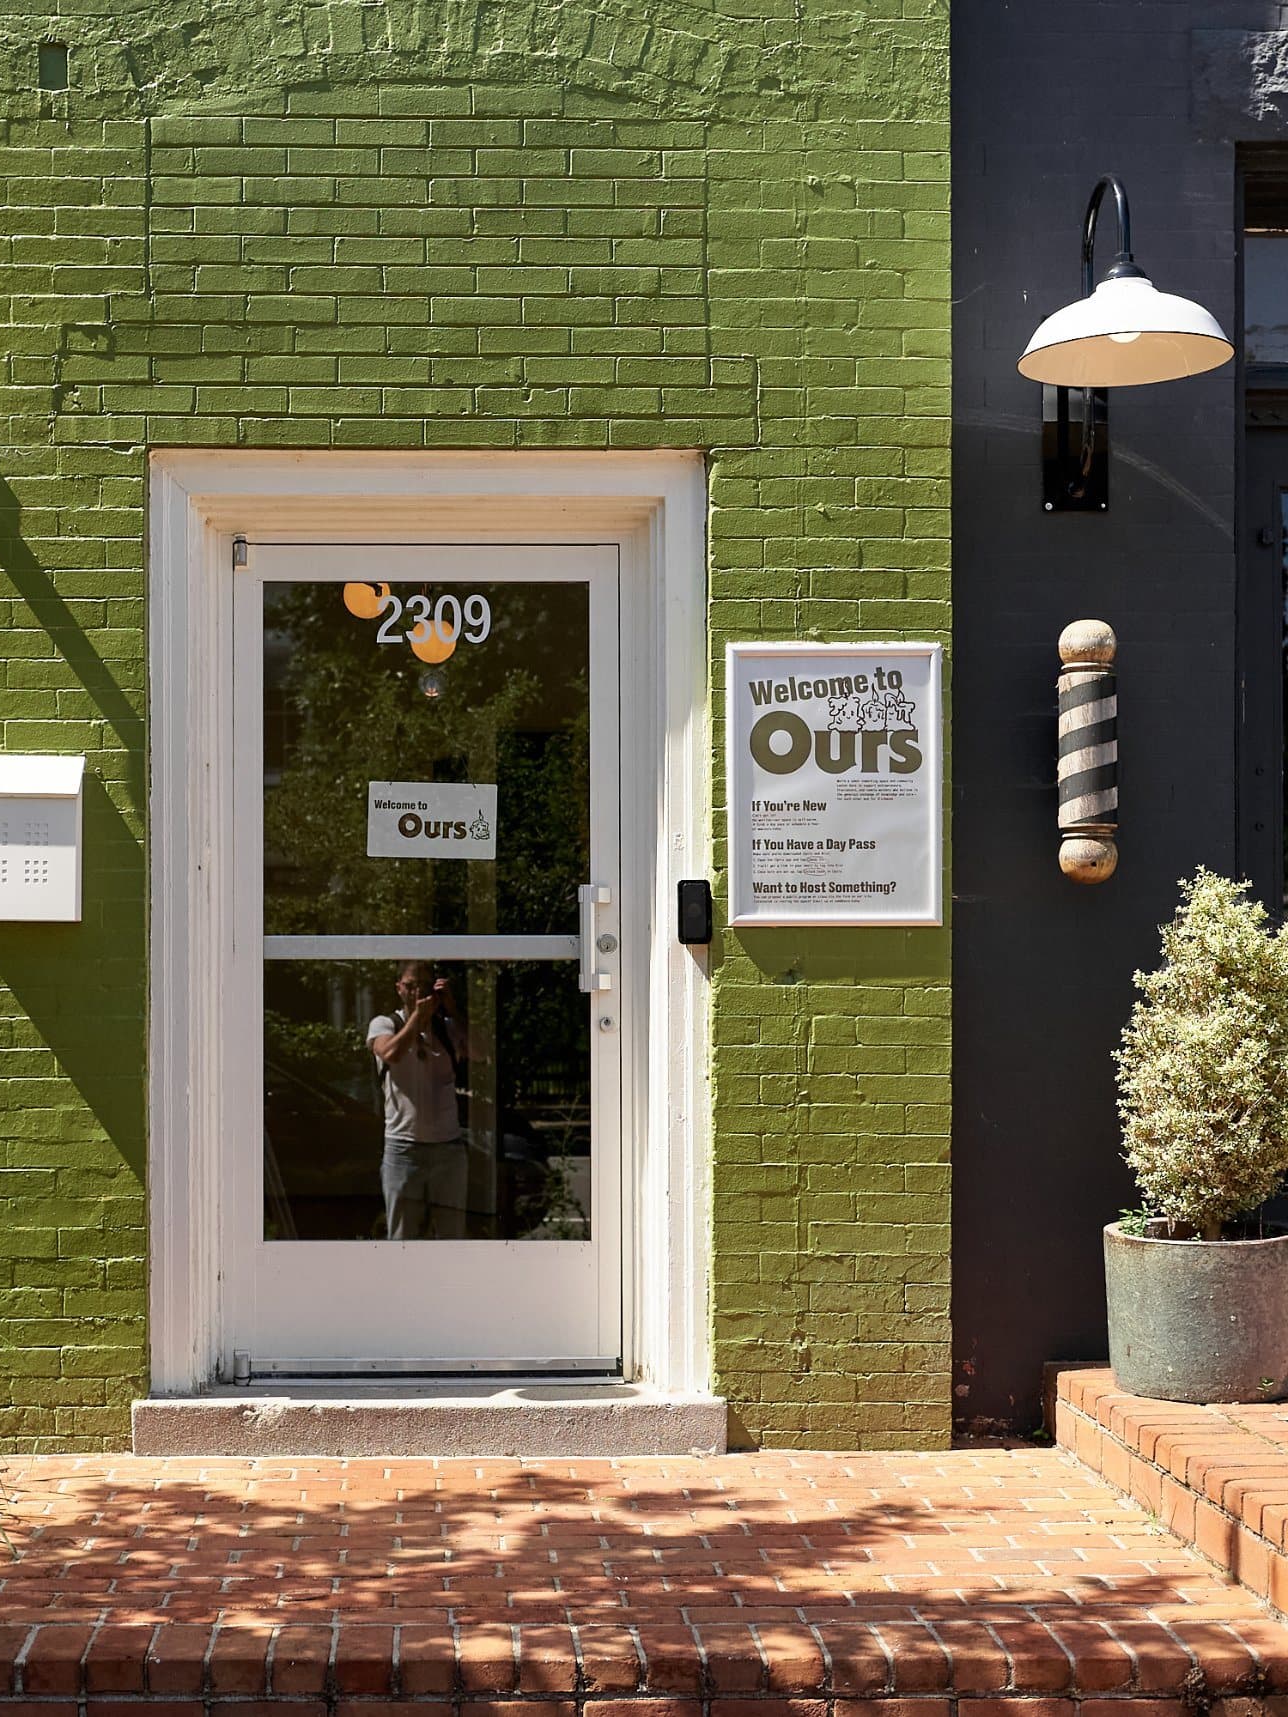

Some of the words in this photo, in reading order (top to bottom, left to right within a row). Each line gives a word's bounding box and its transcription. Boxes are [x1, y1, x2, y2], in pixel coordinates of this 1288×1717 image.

[376, 594, 492, 644] 2309
[749, 673, 869, 706] Welcome
[874, 666, 903, 691] to
[750, 711, 922, 774] Ours
[374, 799, 416, 810] Welcome
[418, 801, 428, 810] to
[752, 800, 761, 811] If
[763, 800, 800, 812] You're
[803, 800, 827, 812] New
[398, 812, 467, 839] Ours
[752, 839, 761, 850] If
[764, 839, 784, 850] You
[787, 839, 814, 850] Have
[816, 841, 824, 850] a
[826, 839, 847, 852] Day
[848, 839, 876, 850] Pass
[753, 882, 783, 893] Want
[785, 882, 798, 893] to
[800, 882, 827, 893] Host
[829, 881, 897, 895] Something?
